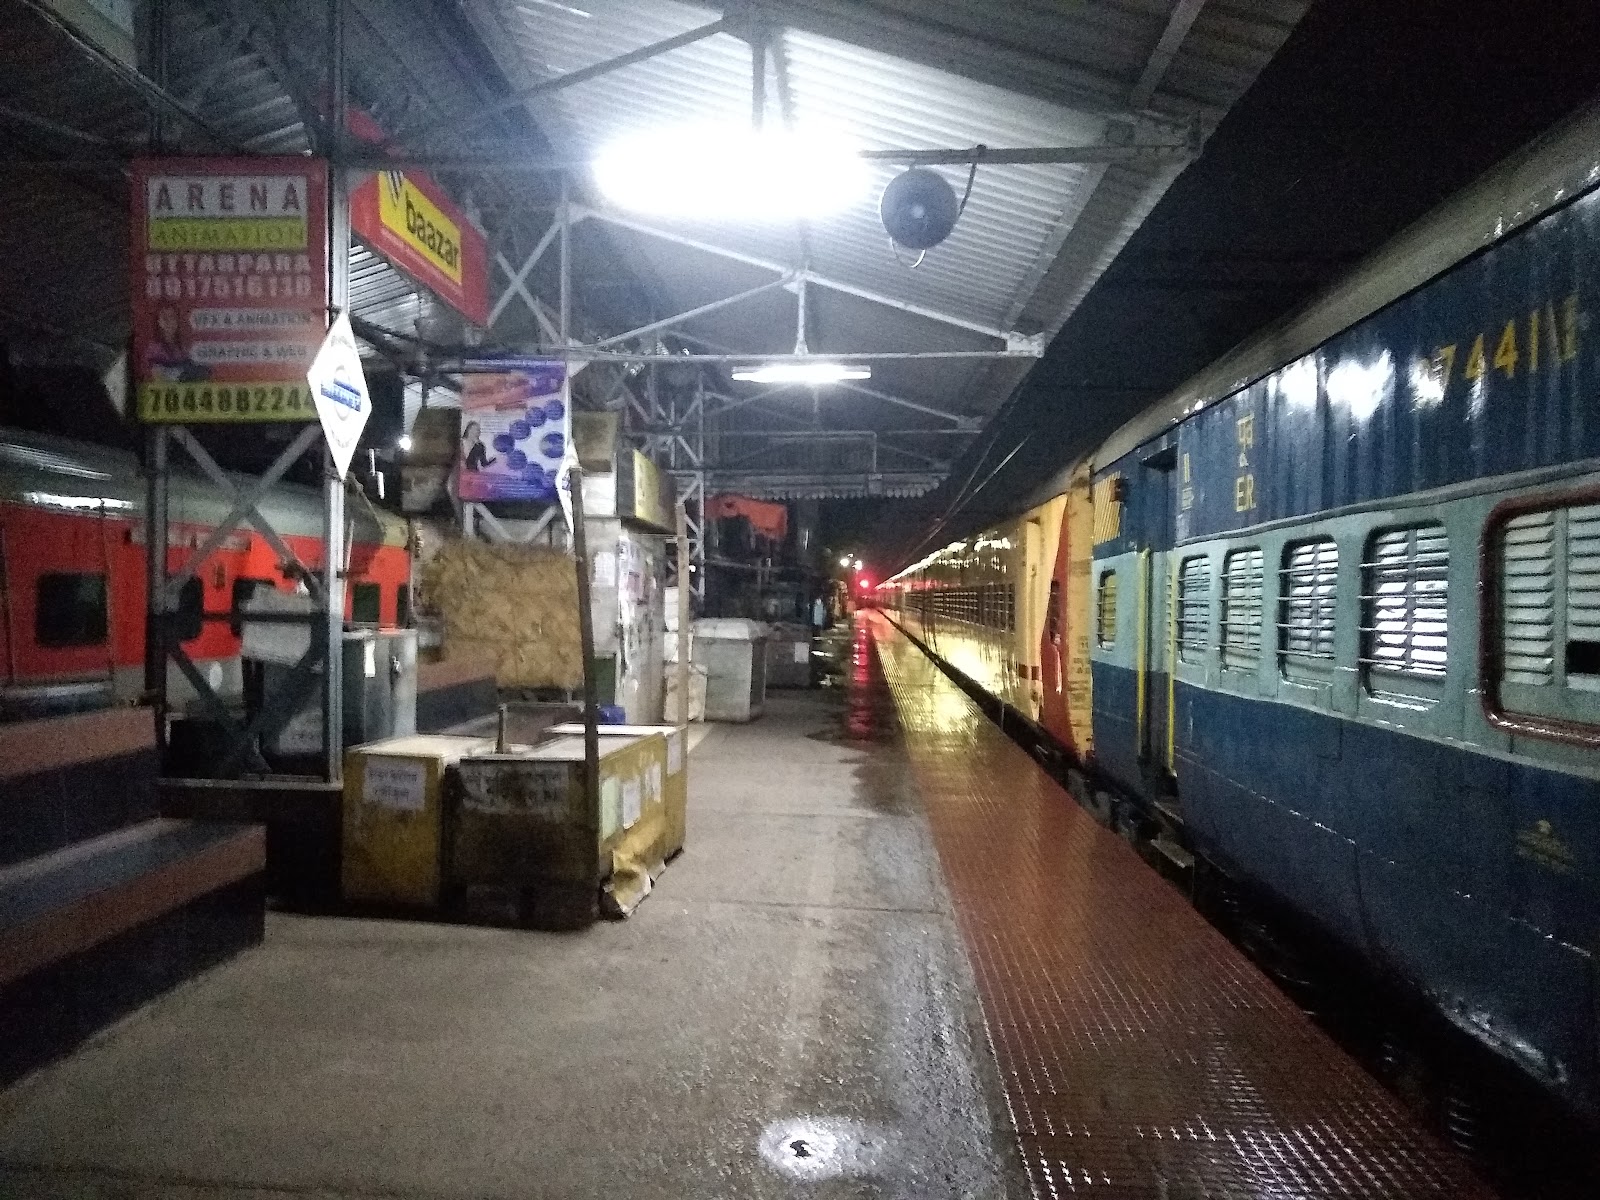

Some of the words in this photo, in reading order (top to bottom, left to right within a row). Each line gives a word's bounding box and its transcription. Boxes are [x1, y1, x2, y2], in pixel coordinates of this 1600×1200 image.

[155, 182, 301, 211] ARENA
[154, 226, 304, 244] ANIMATION
[405, 189, 459, 272] baazar
